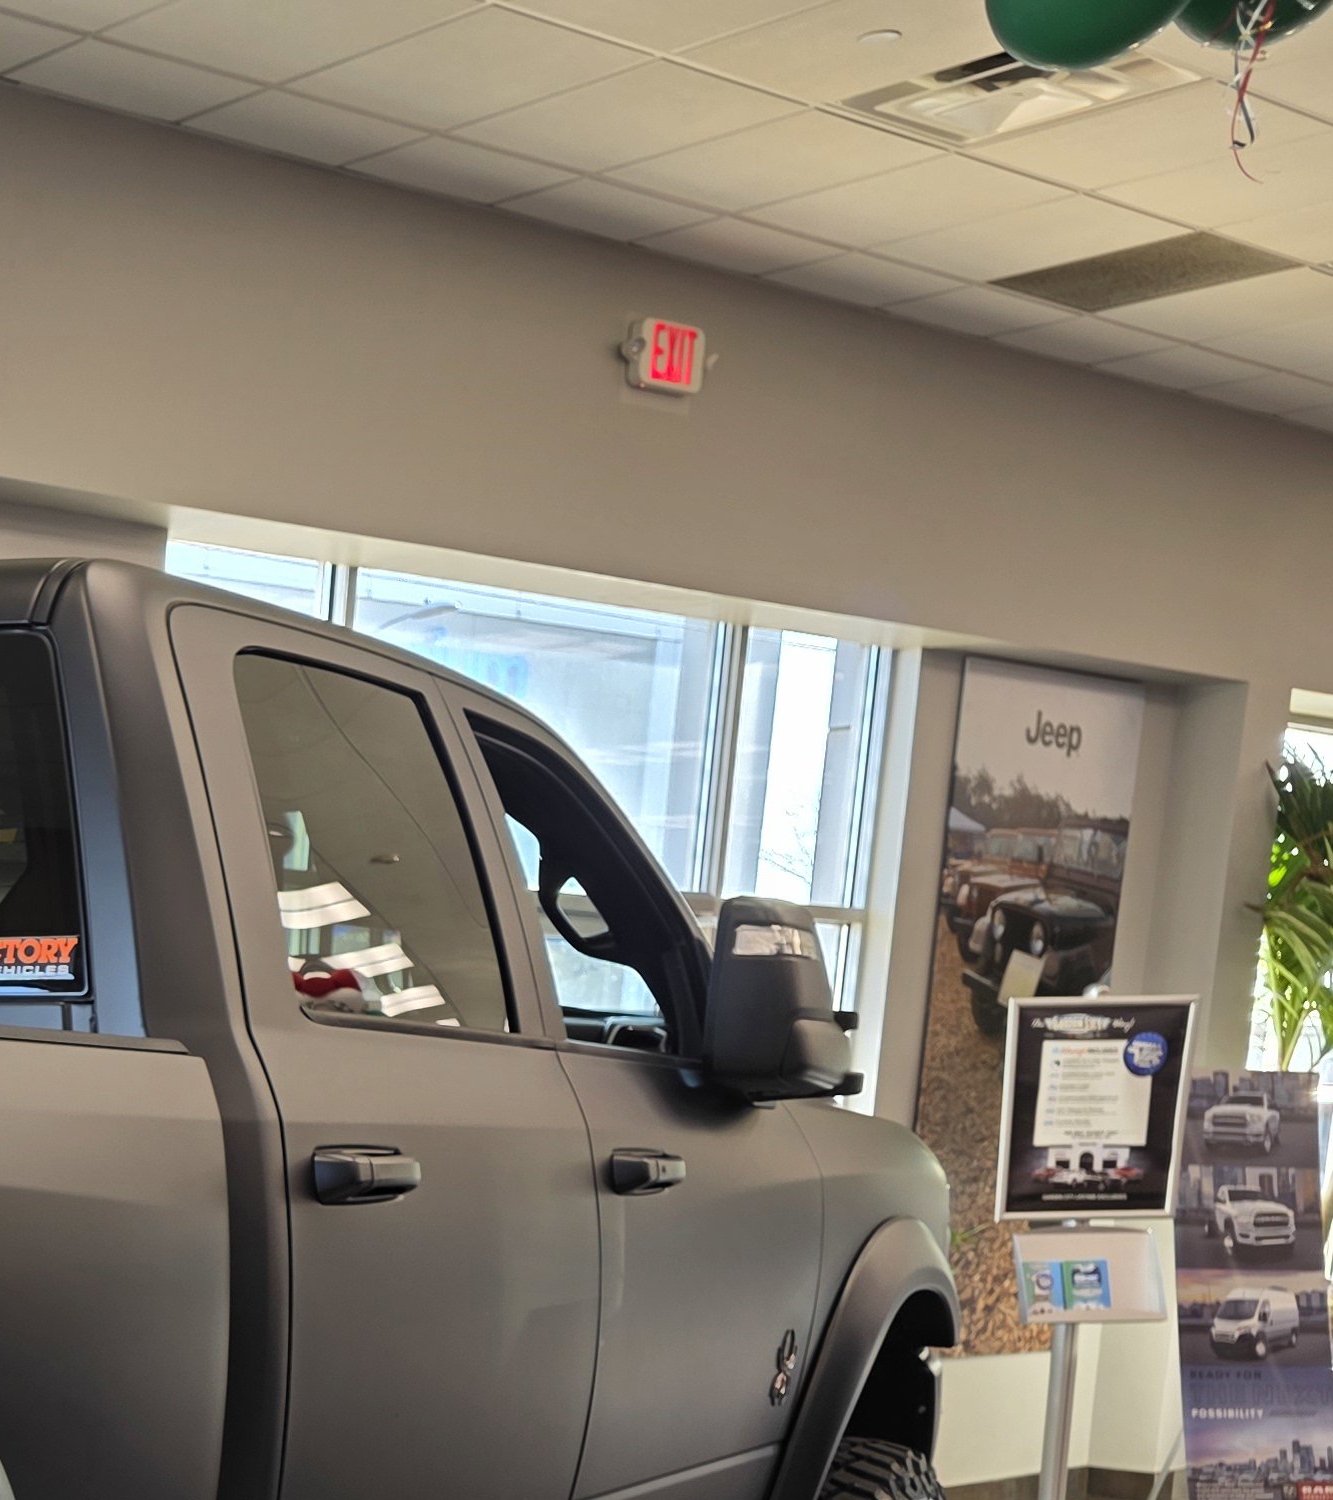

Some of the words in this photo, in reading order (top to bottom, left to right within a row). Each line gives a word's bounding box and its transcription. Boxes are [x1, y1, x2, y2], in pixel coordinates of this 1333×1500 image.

[650, 322, 698, 386] EXIT
[1025, 709, 1082, 758] Jeep
[1191, 1408, 1264, 1420] POSSIBILITY
